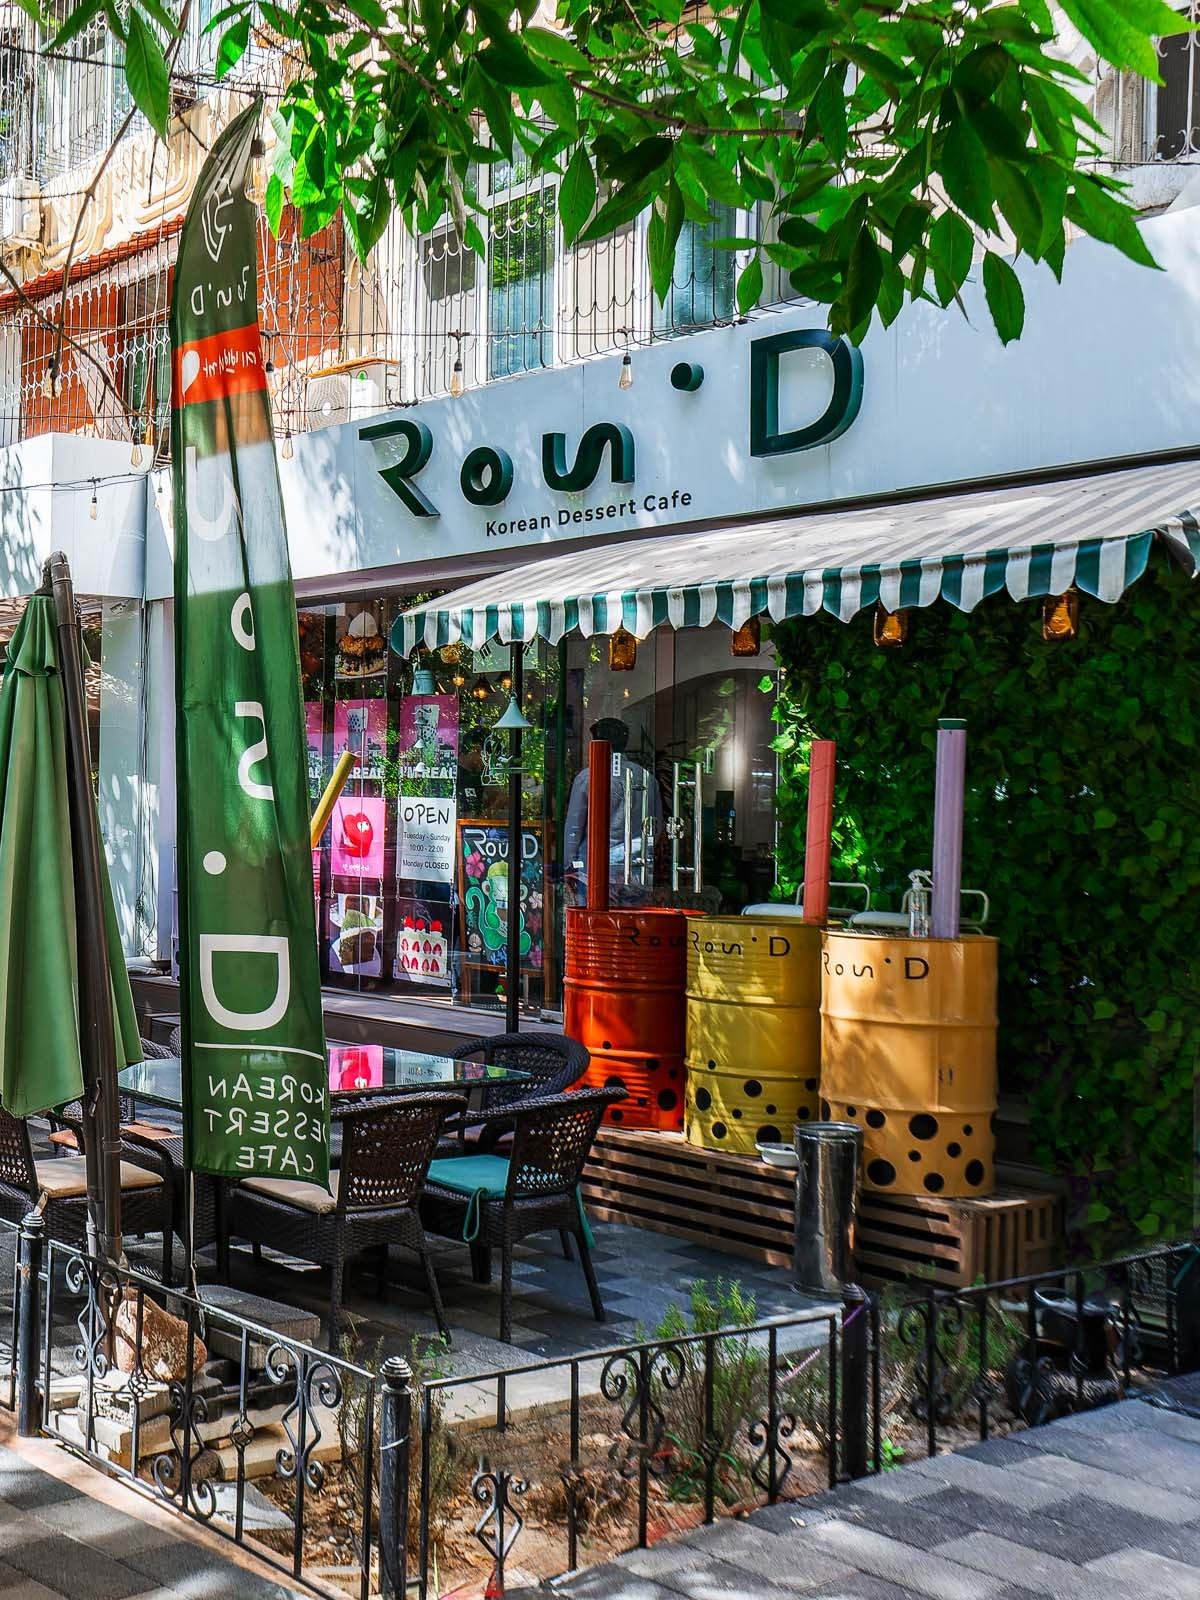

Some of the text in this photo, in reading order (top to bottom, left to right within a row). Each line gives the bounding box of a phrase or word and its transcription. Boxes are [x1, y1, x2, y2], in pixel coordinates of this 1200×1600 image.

[486, 490, 692, 537] Korean Dessert Cafe
[404, 803, 450, 825] OPEN
[403, 831, 426, 842] Tuesday
[429, 832, 450, 843] Sunday
[428, 844, 444, 853] 22:00
[402, 859, 450, 870] Monday CLOSED
